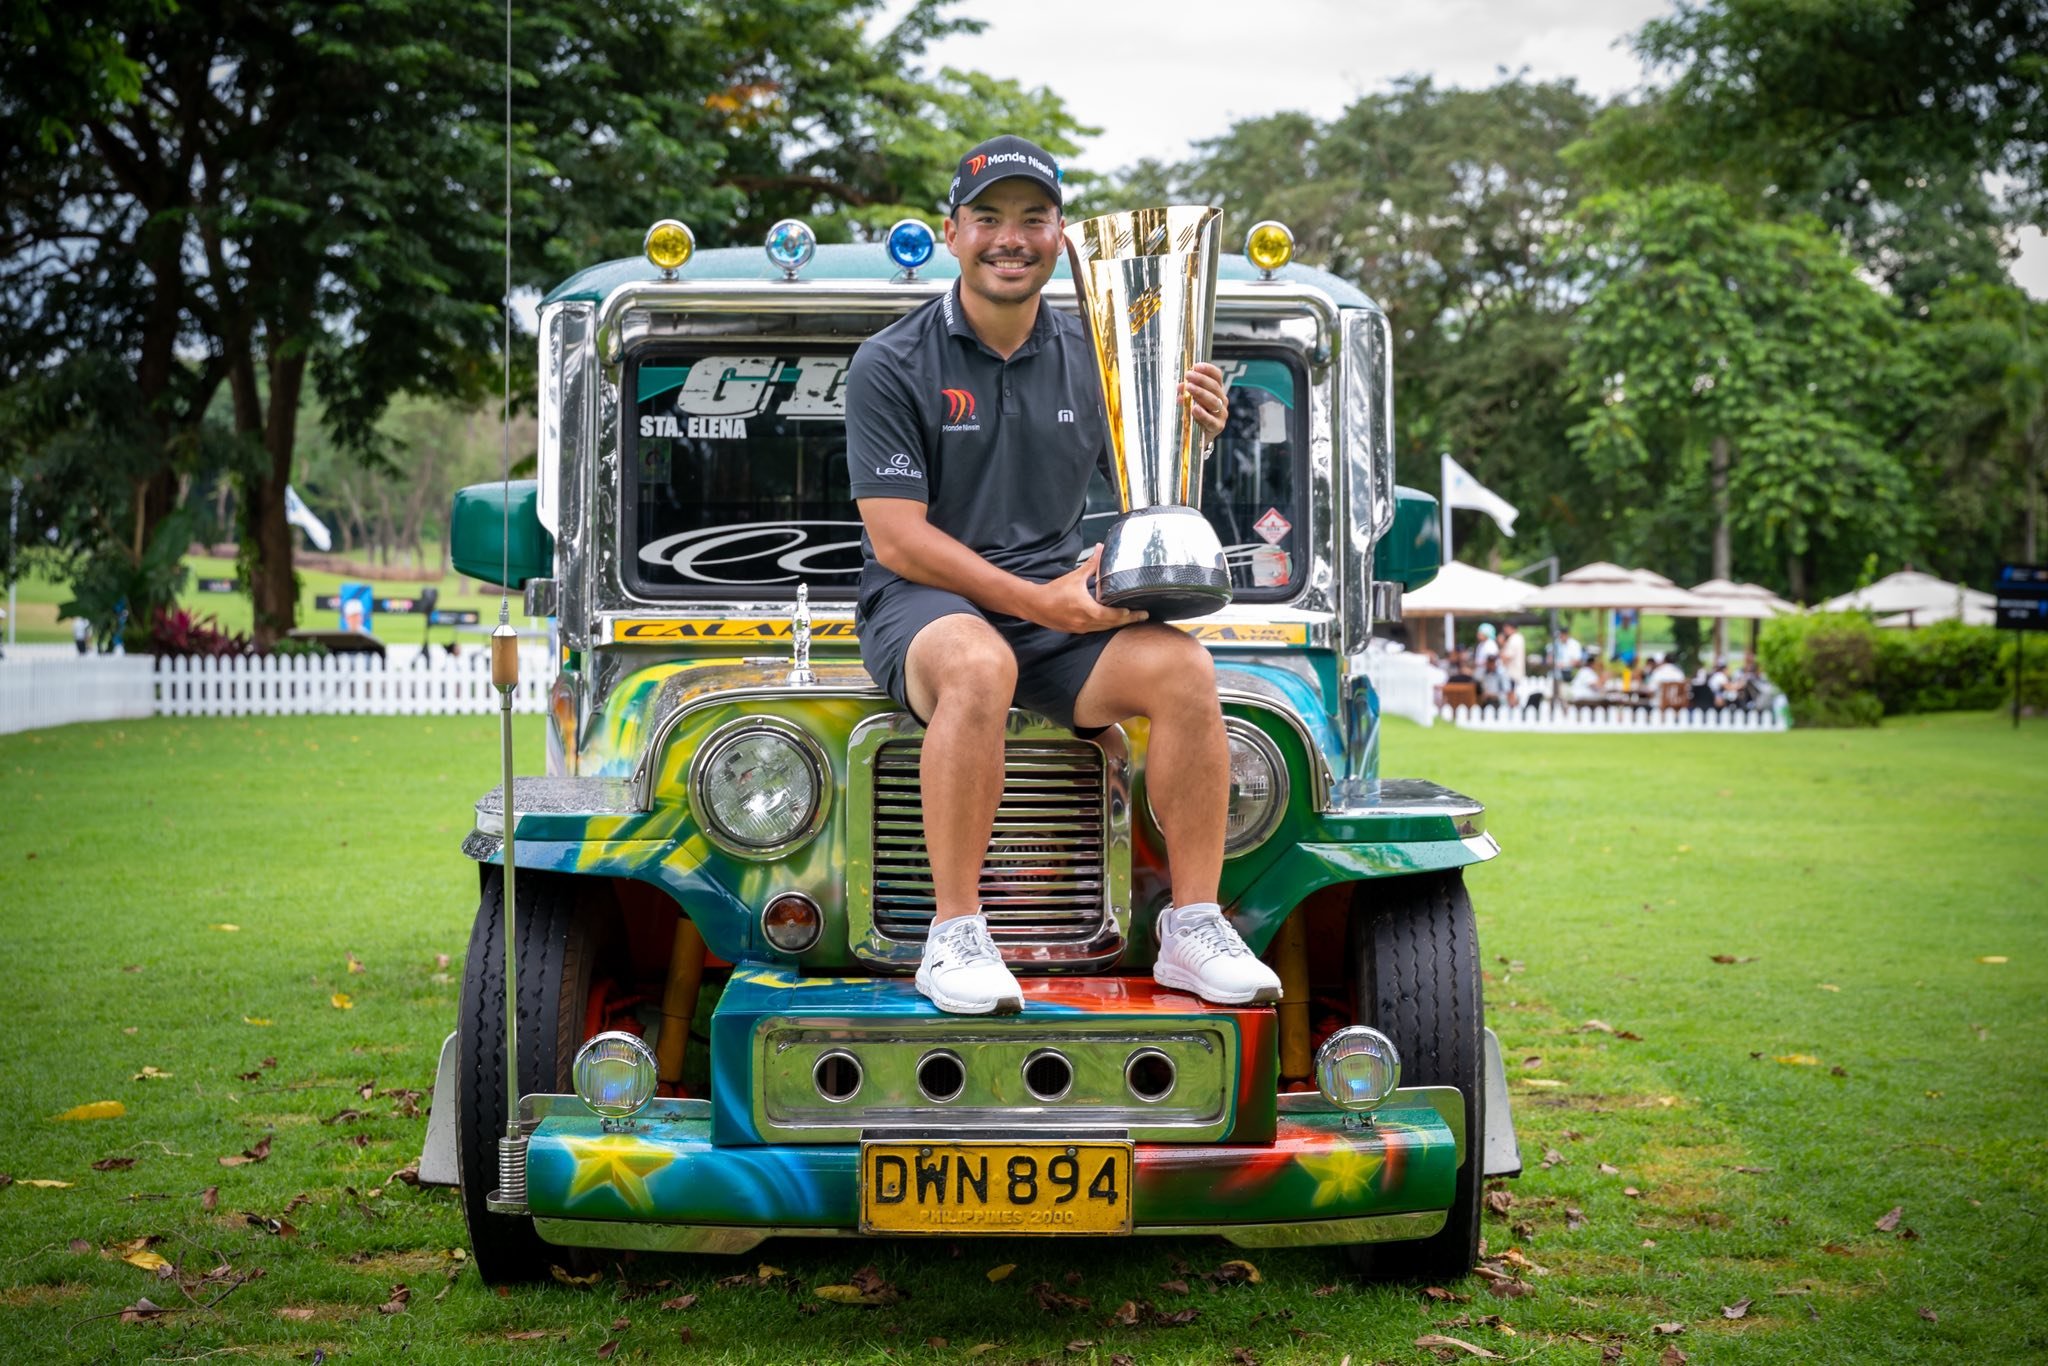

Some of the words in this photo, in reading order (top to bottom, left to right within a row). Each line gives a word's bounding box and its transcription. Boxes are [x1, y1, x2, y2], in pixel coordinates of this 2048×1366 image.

[988, 152, 1026, 166] Monde
[640, 415, 684, 437] STA.
[687, 417, 747, 439] ELENA
[876, 467, 922, 479] LEXUS
[876, 1155, 987, 1203] DWN
[1007, 1155, 1118, 1205] 894
[919, 1210, 1024, 1224] PHILIPPINES
